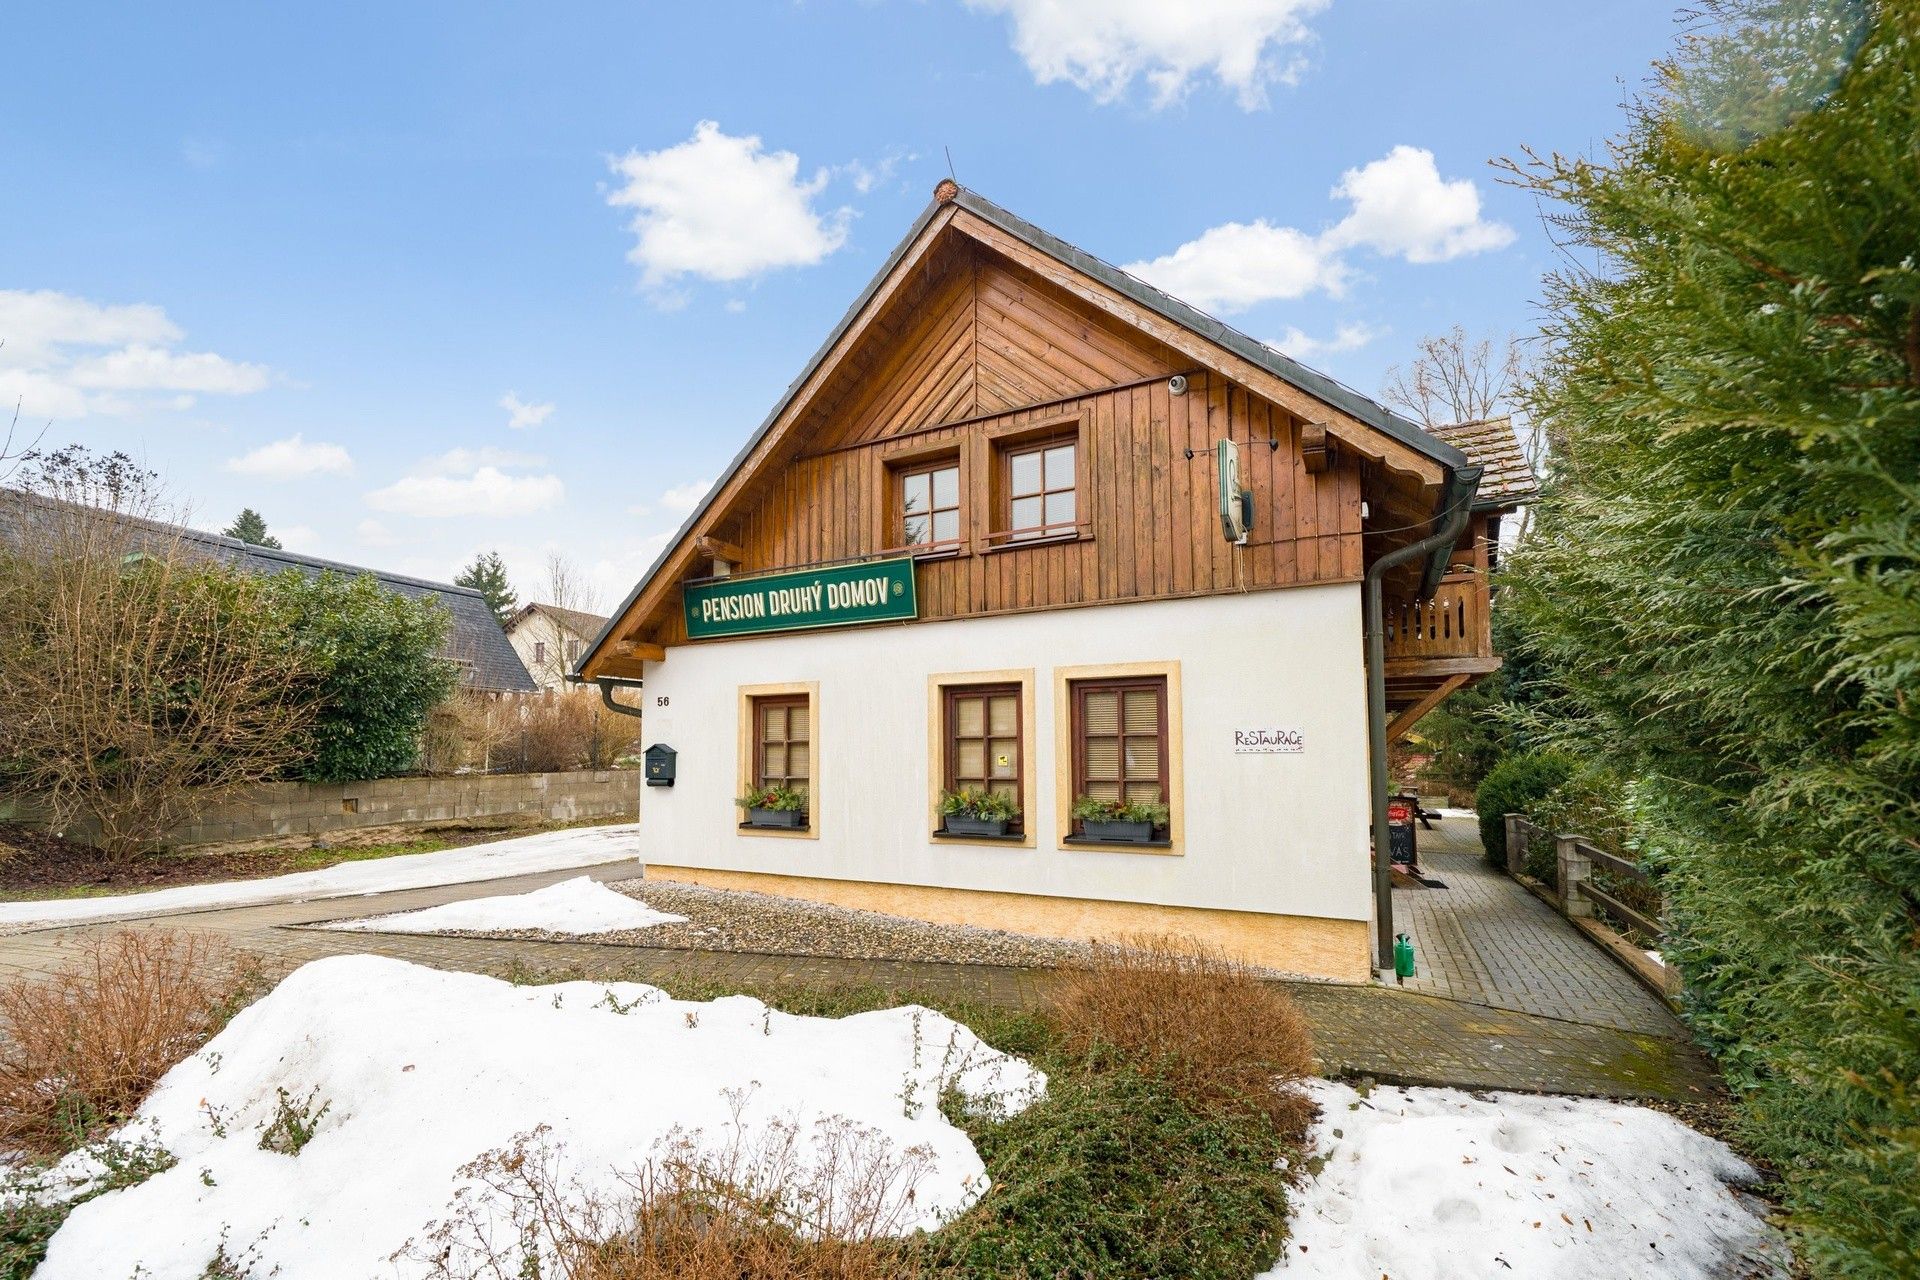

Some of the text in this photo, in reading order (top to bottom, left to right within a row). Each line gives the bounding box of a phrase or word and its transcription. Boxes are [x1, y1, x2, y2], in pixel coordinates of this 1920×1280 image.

[702, 577, 888, 622] PENSION DRUHÝ DOMOV
[657, 697, 669, 706] 56
